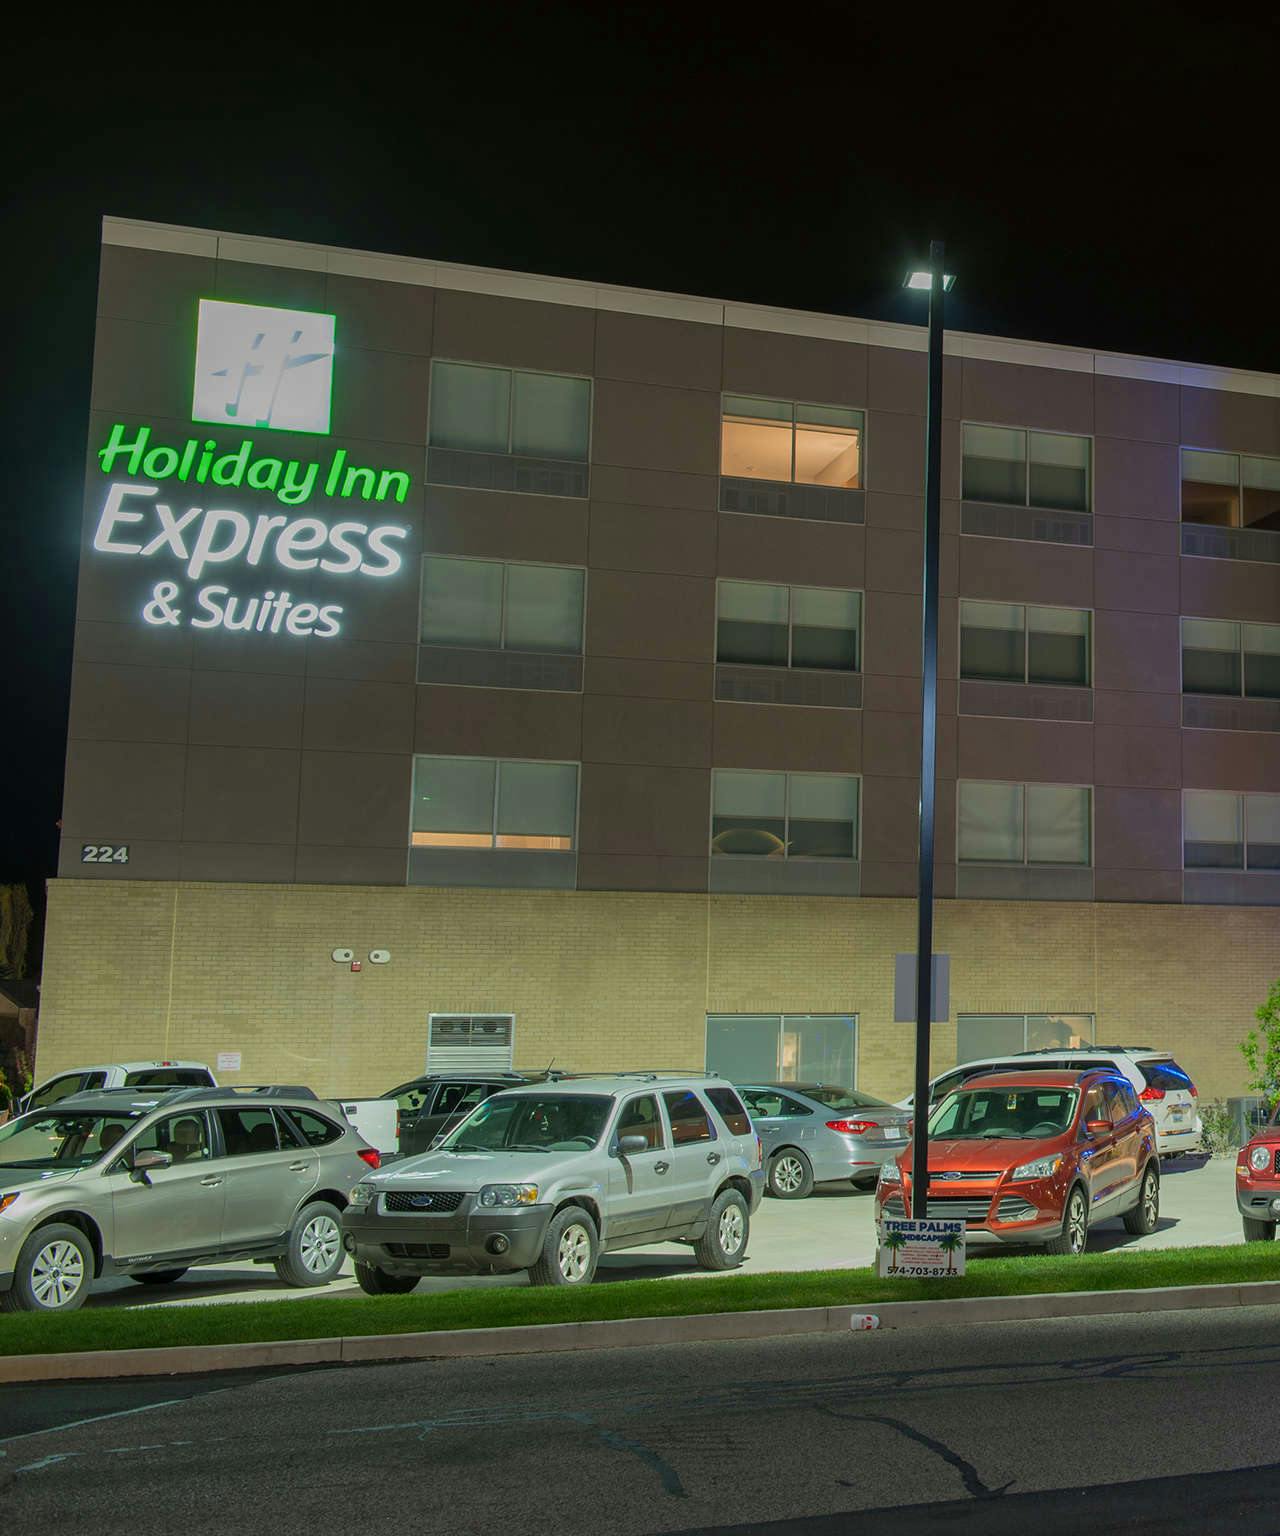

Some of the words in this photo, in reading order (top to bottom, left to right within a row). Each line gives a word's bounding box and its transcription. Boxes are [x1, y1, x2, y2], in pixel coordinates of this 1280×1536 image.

[98, 423, 320, 505] Holiday
[325, 449, 410, 503] Inn
[93, 482, 407, 580] Express
[142, 580, 182, 627] &
[191, 584, 344, 637] Suites
[82, 845, 129, 863] 224
[884, 1221, 917, 1232] TREE
[919, 1222, 962, 1233] PALMS
[887, 1266, 958, 1276] 574-703-8733
